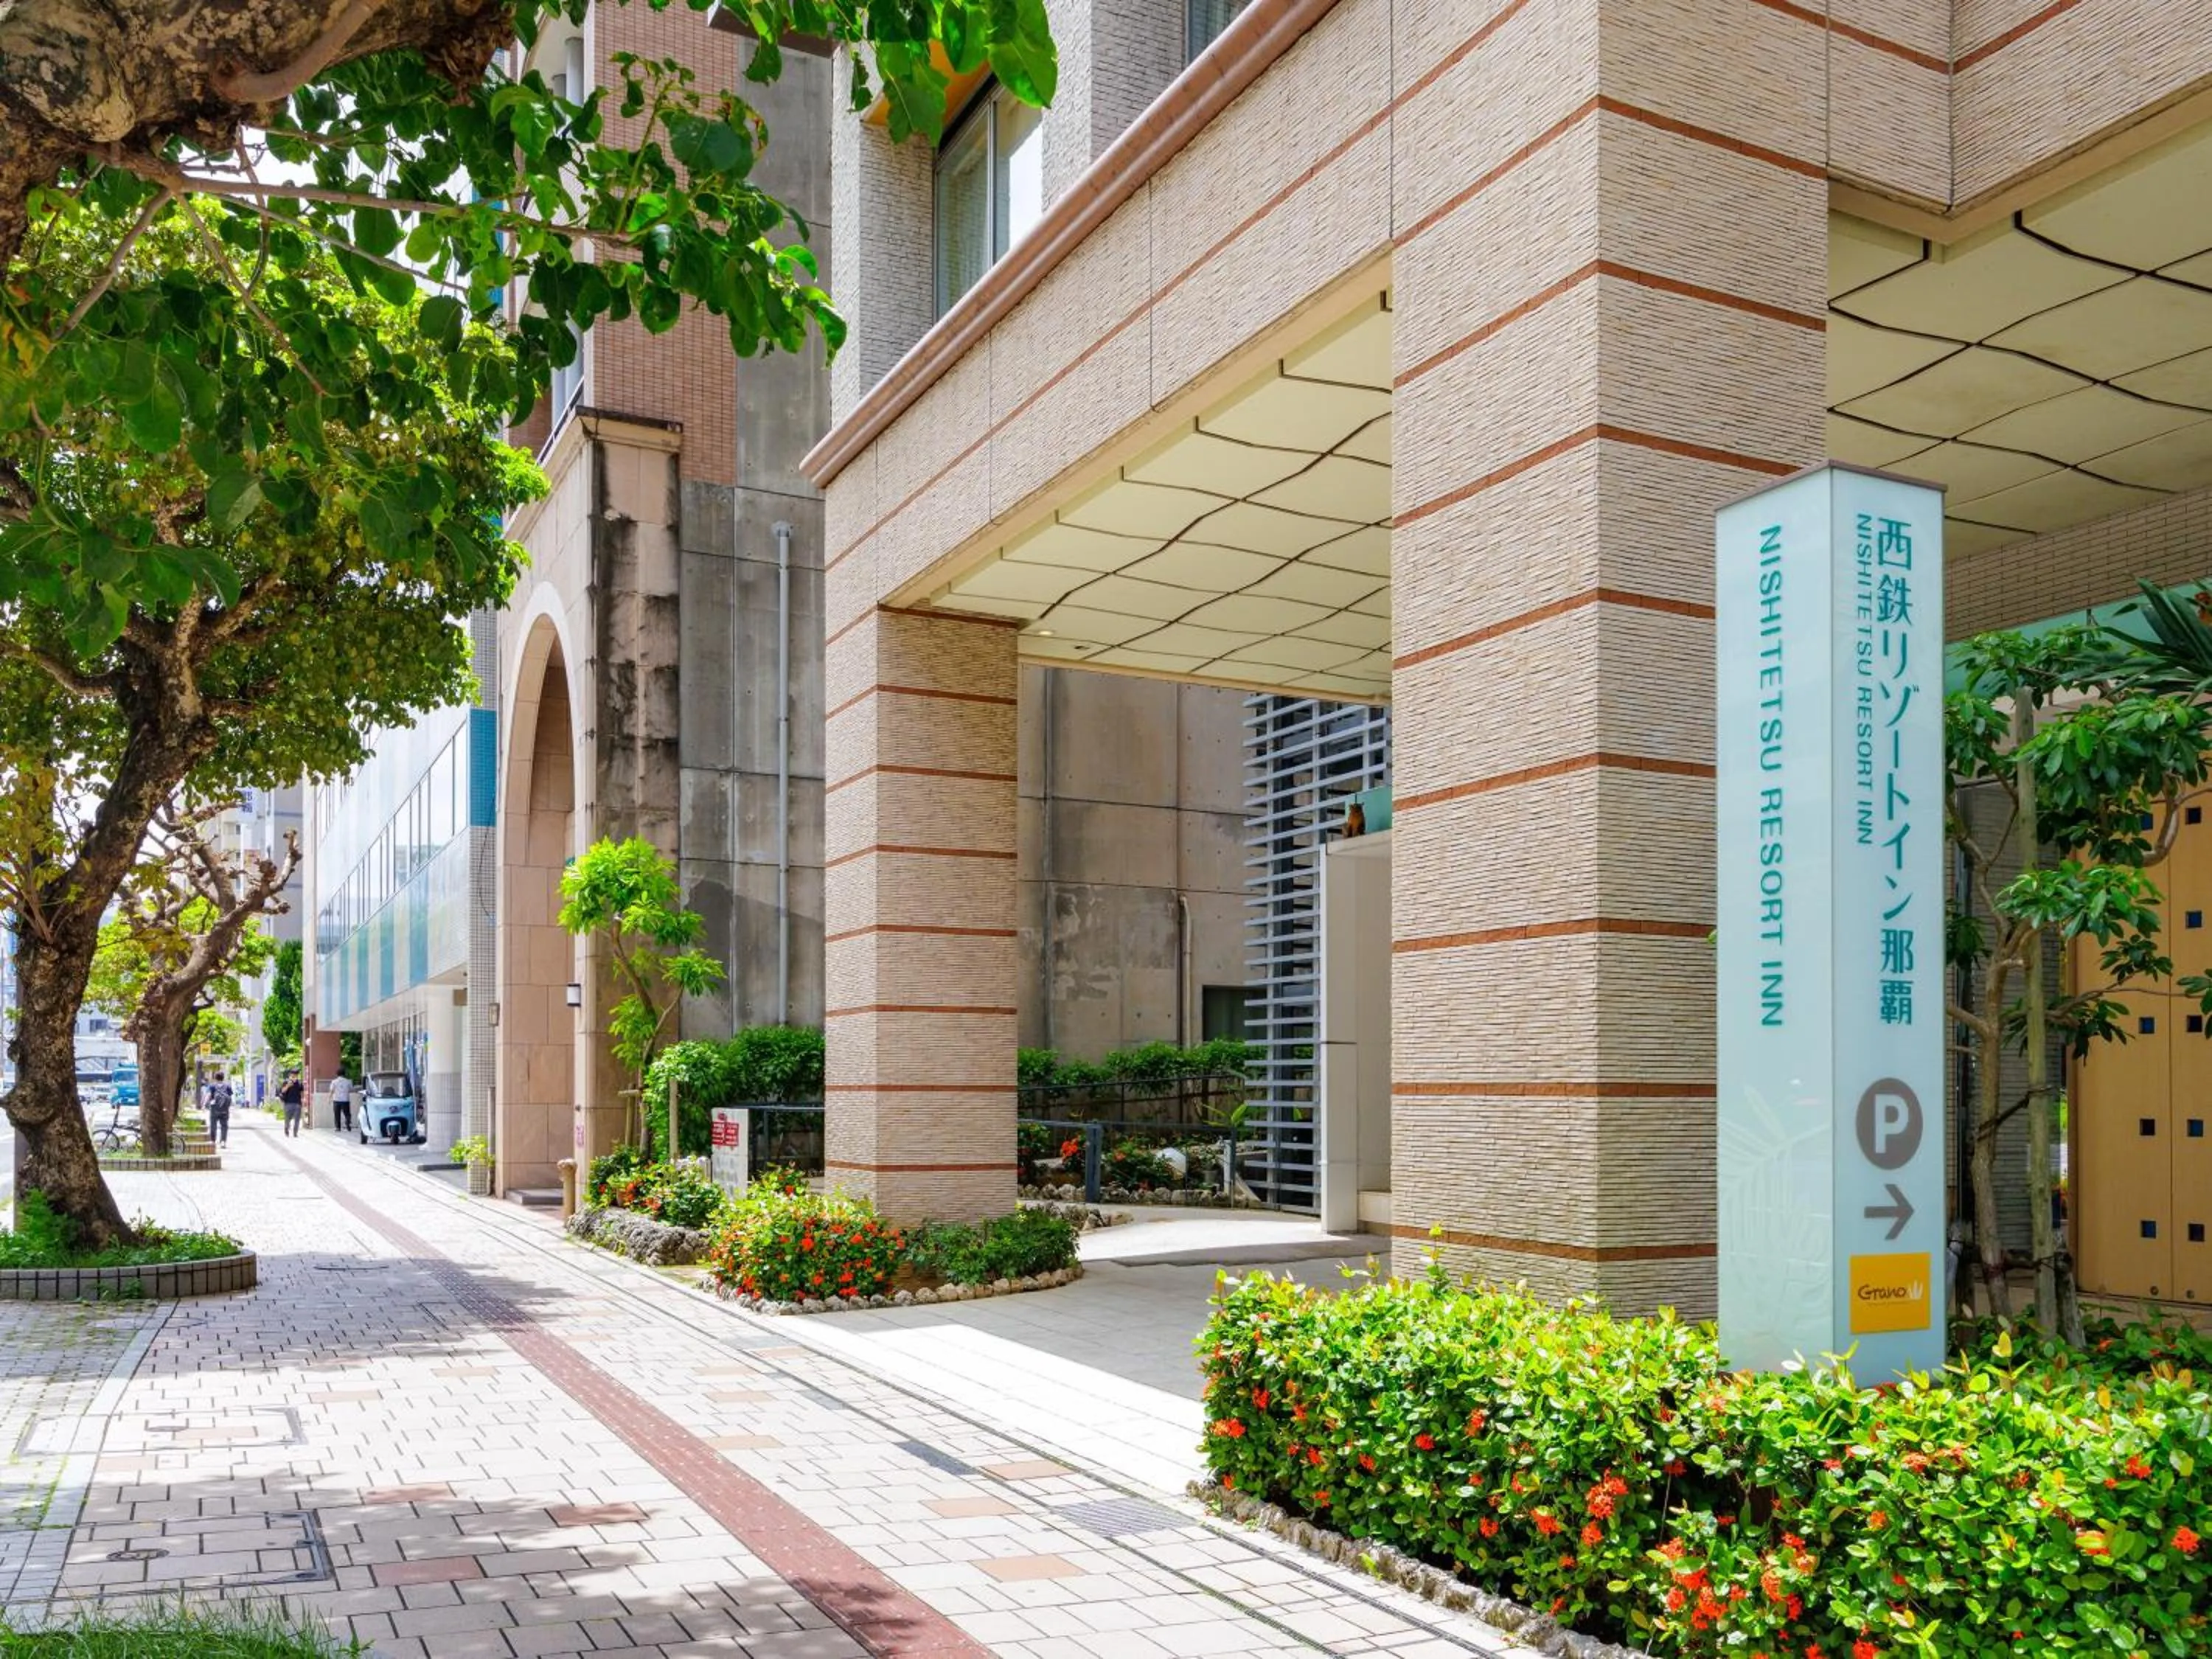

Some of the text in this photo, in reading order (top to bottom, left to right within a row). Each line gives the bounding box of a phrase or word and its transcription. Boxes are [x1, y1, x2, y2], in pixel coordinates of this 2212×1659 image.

[1759, 524, 1784, 1027] NISHITETSU RESORT INN
[1856, 513, 1873, 846] NISHITETSU RESORT INN
[1877, 517, 1919, 1026] 西鉄リゾートイン那覇
[1874, 1093, 1910, 1154] P
[1857, 1284, 1907, 1301] Grano
